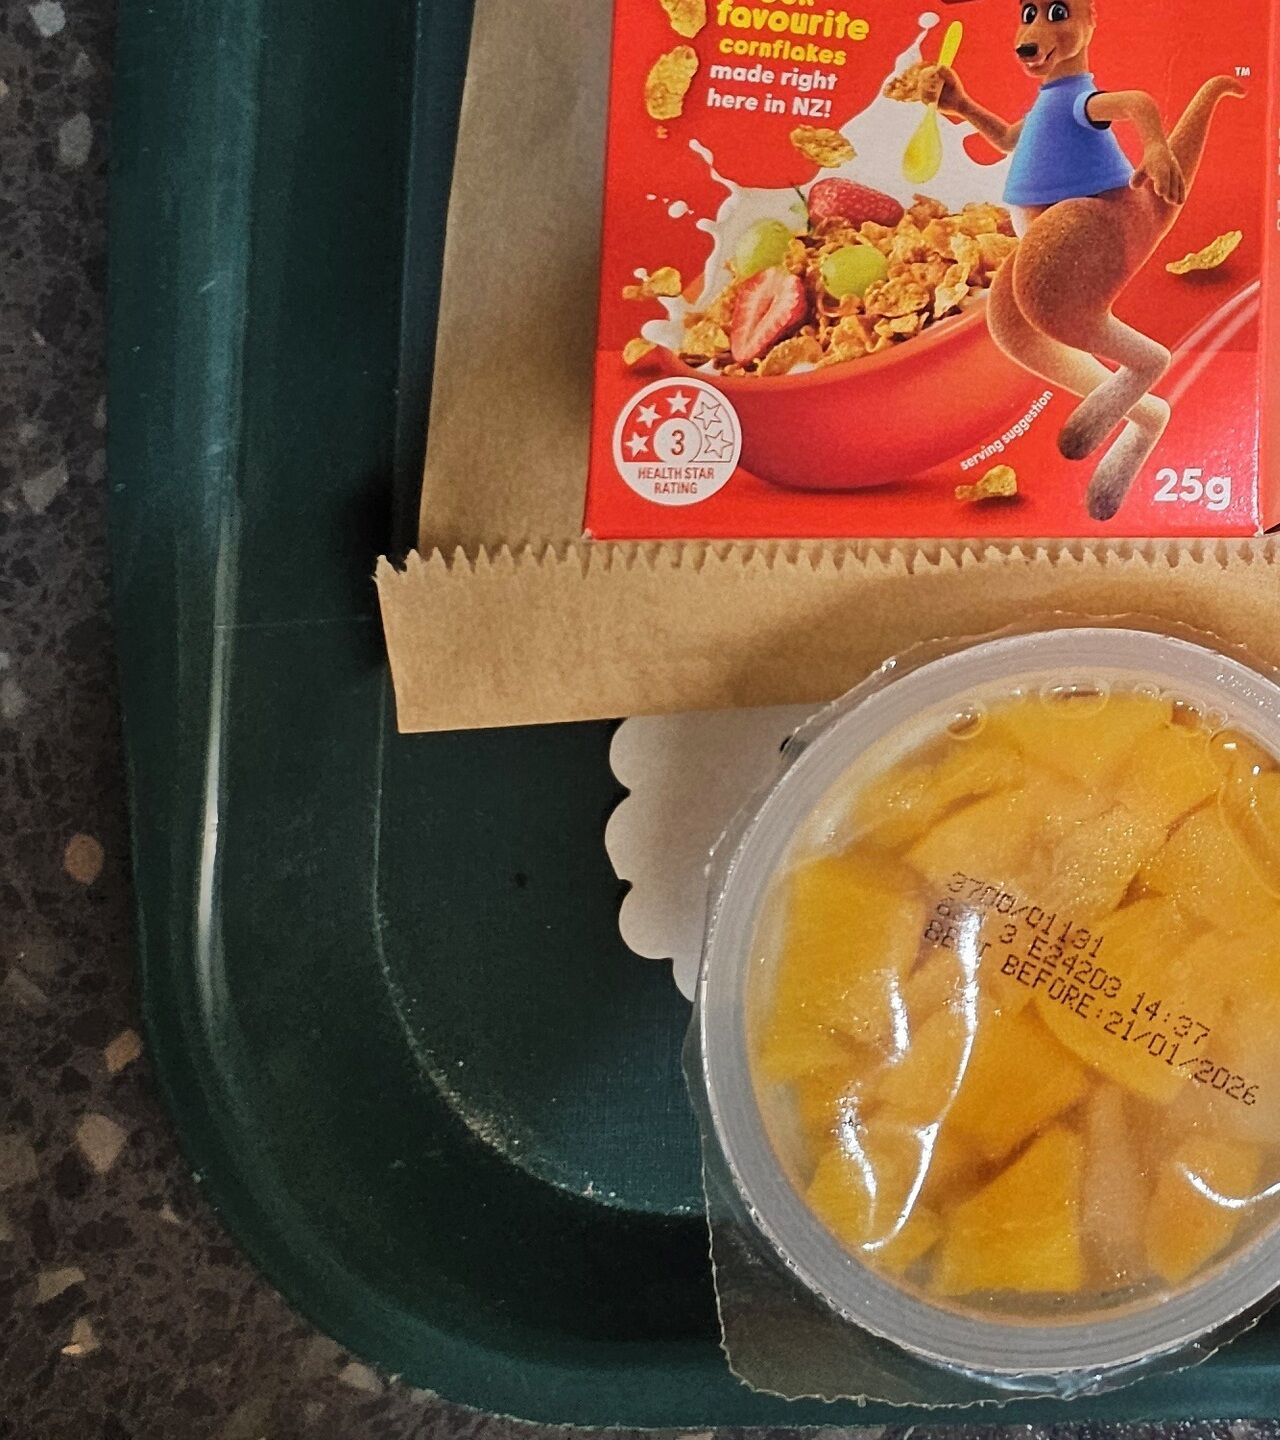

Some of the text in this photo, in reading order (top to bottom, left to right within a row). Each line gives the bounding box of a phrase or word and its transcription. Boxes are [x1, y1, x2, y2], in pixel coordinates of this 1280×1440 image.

[719, 38, 847, 66] cornflakes
[710, 64, 838, 92] made right
[707, 87, 832, 118] here in NZ!
[671, 429, 685, 456] 3
[960, 390, 1054, 471] serving suggestion
[638, 467, 715, 479] HEALTH STAR
[654, 482, 698, 494] RATING
[1154, 467, 1232, 510] 25g
[1027, 936, 1211, 1046] E24203 14:37
